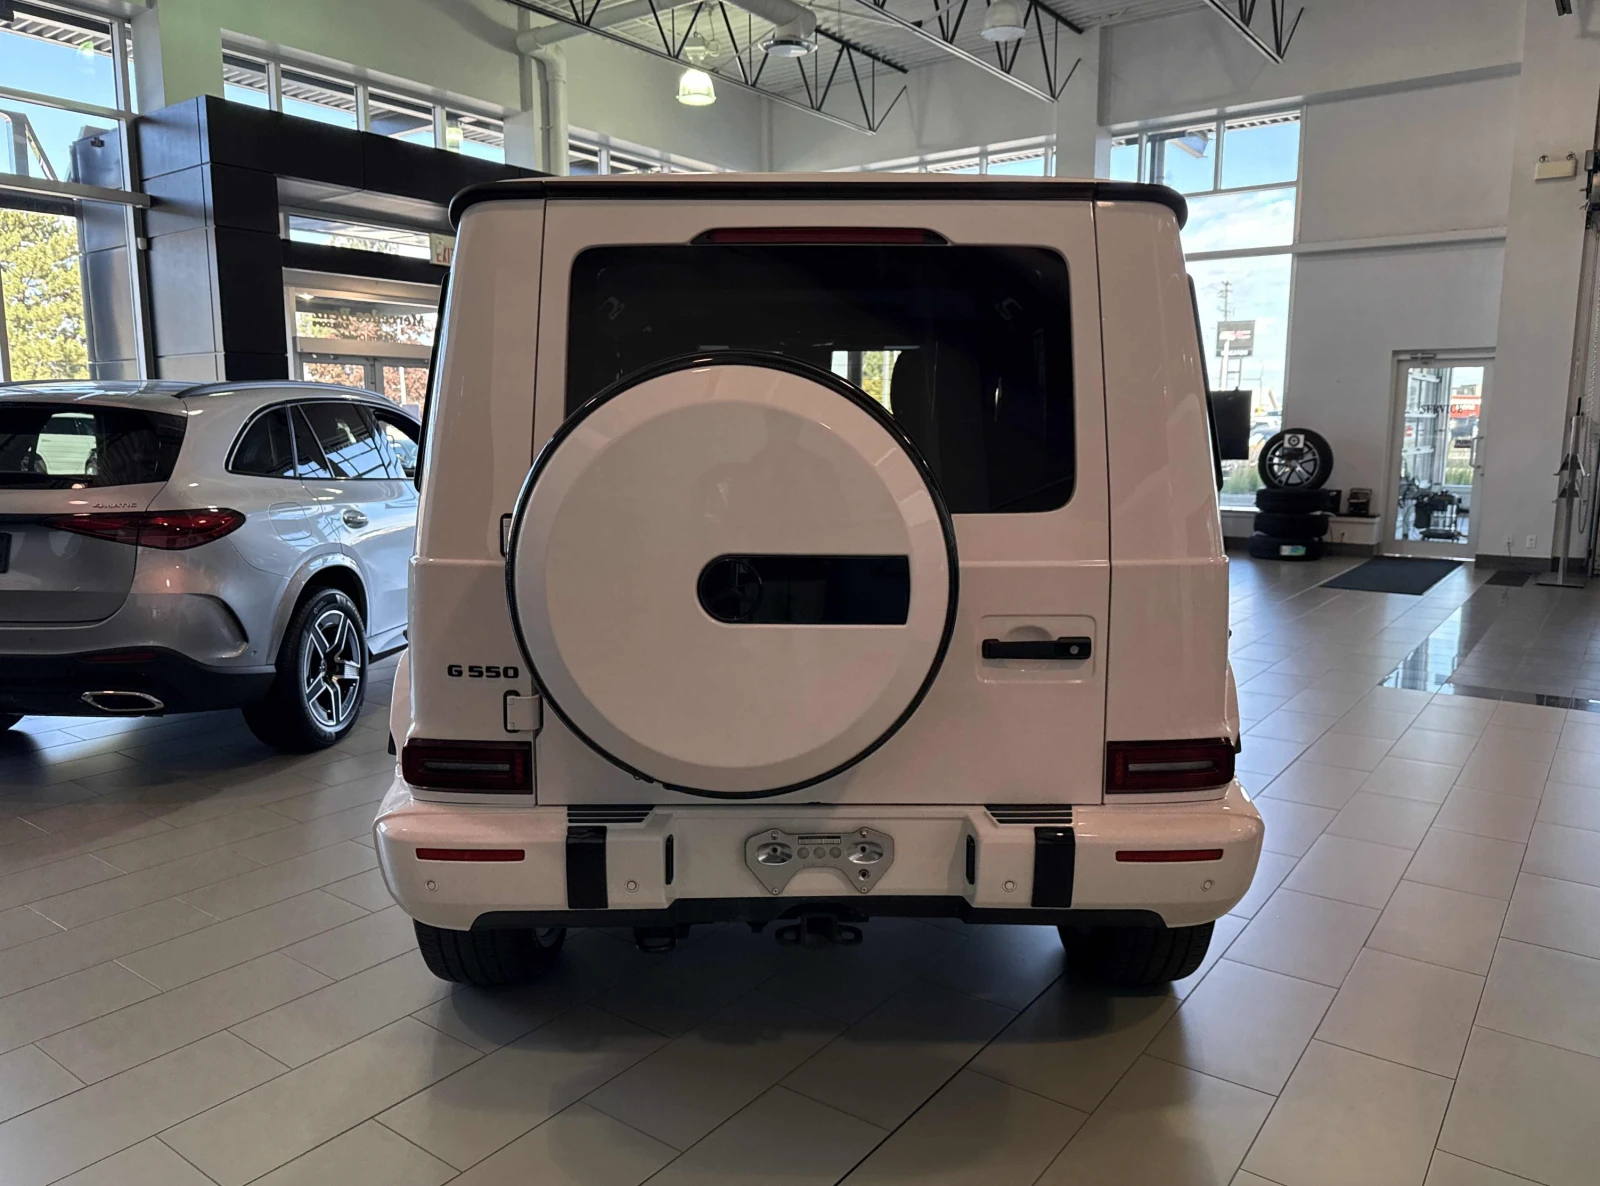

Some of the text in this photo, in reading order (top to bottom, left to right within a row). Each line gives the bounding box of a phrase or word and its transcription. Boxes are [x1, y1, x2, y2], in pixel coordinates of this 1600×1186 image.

[1420, 404, 1464, 415] SERVICE
[447, 664, 519, 679] G 550
